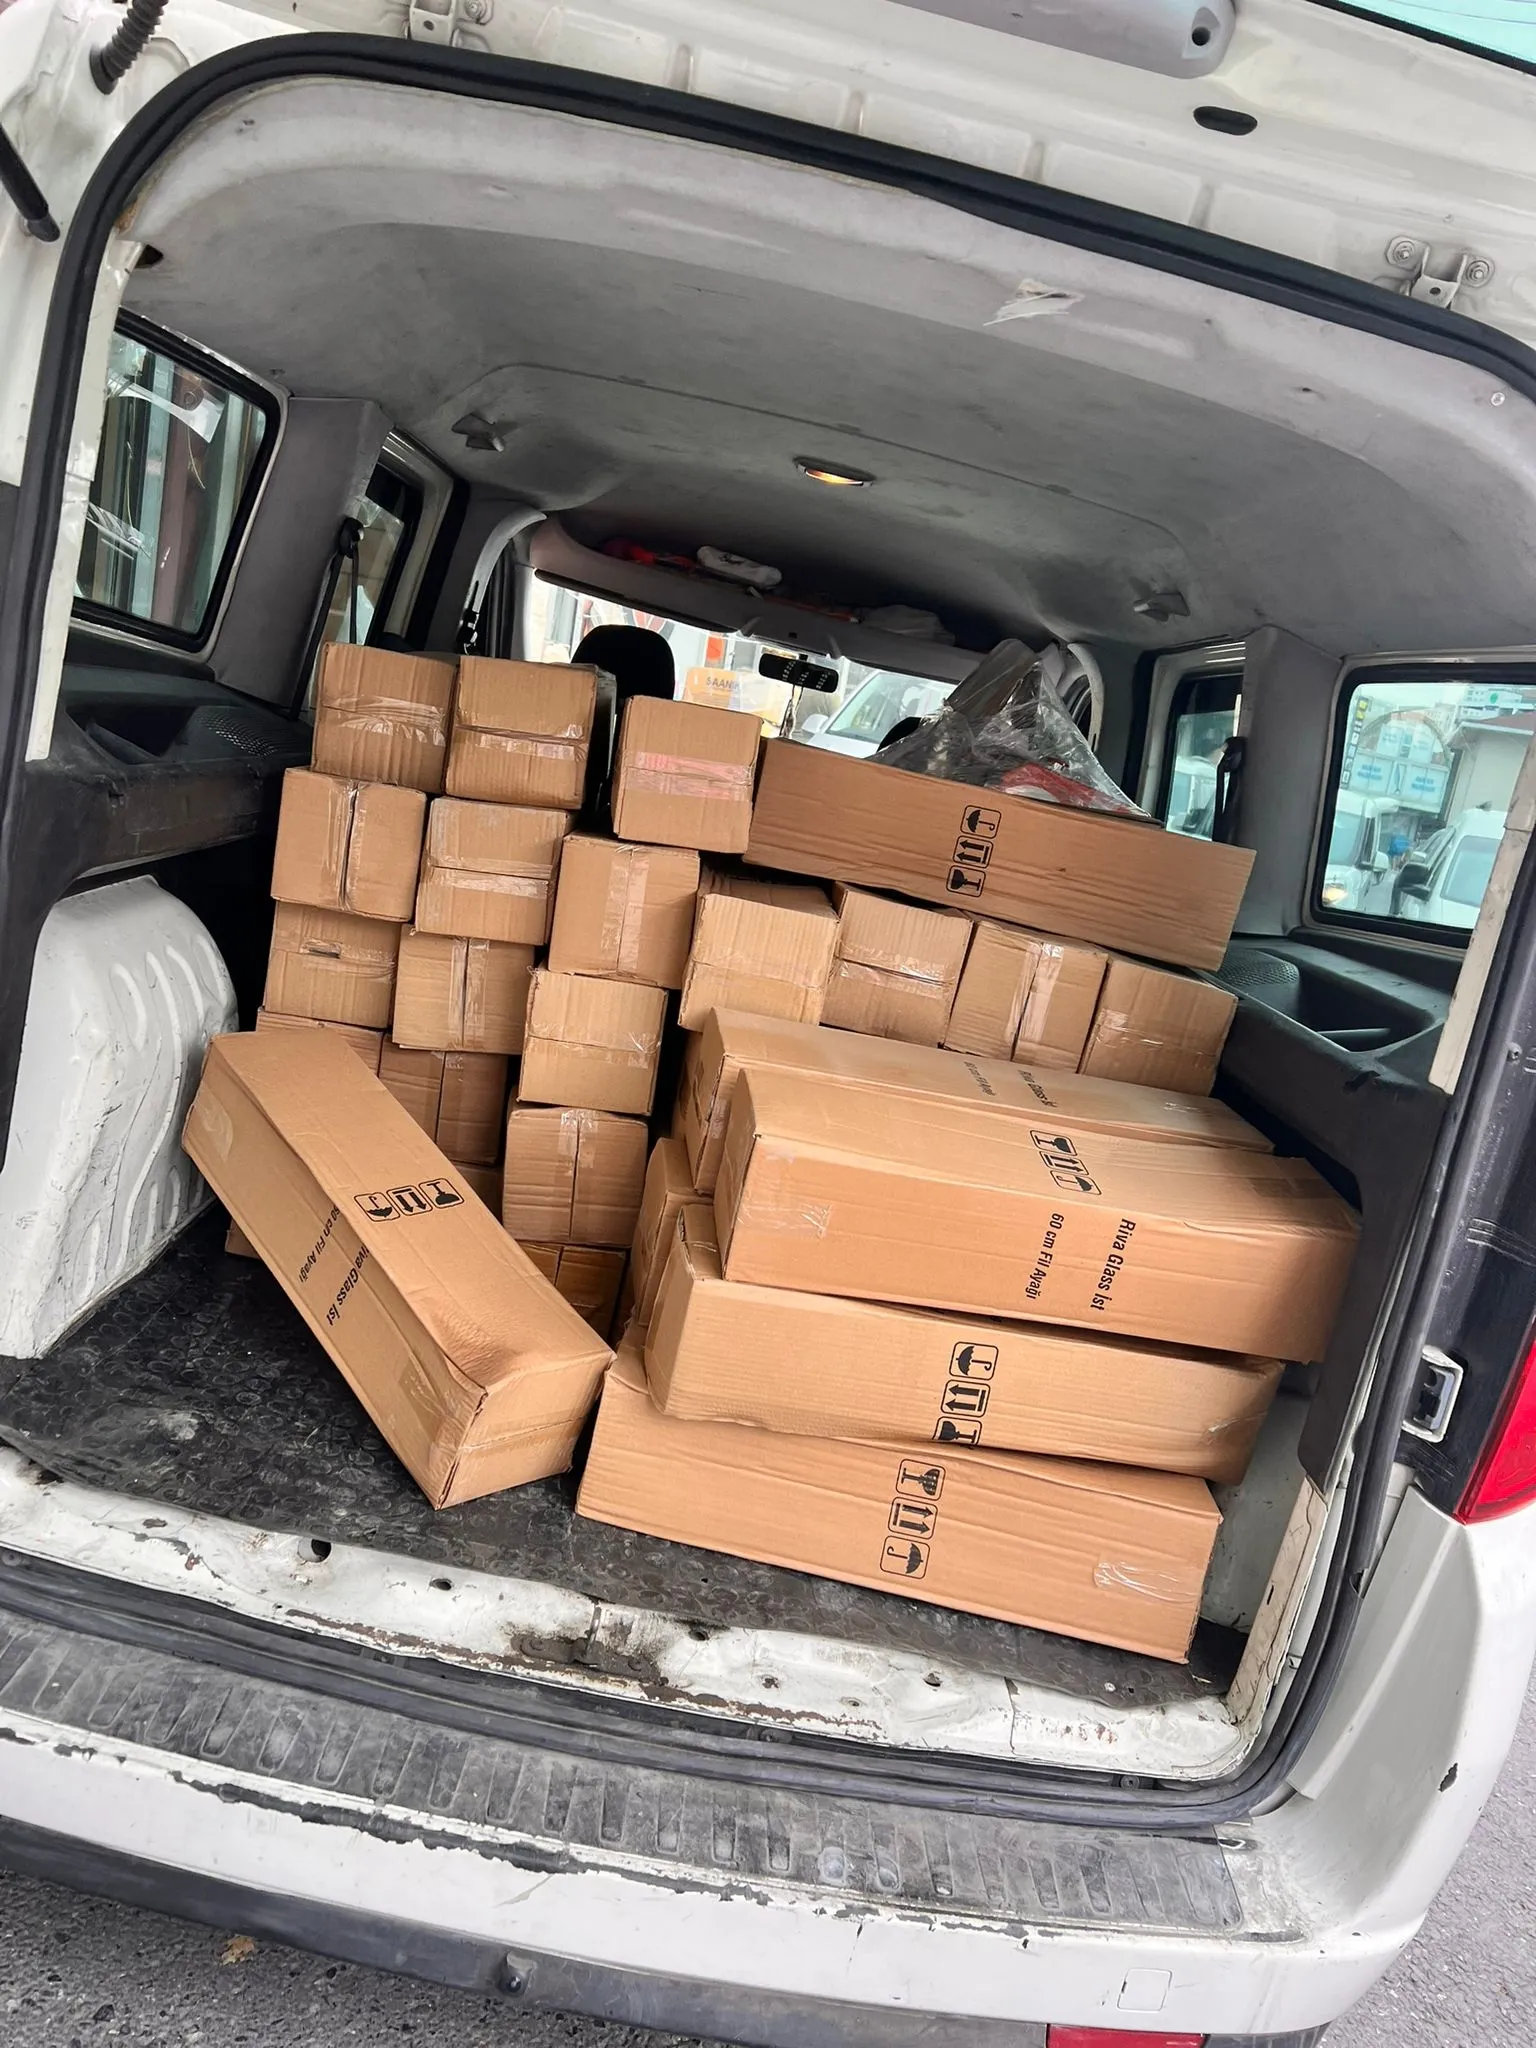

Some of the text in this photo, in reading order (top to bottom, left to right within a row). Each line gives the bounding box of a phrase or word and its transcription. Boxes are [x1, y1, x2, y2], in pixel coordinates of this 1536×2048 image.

[315, 1236, 326, 1255] Fil
[1112, 1218, 1136, 1250] Riva
[1024, 1213, 1065, 1300] 60 cm Fil Ayağı
[1098, 1253, 1124, 1291] Glass
[337, 1267, 359, 1306] Glass
